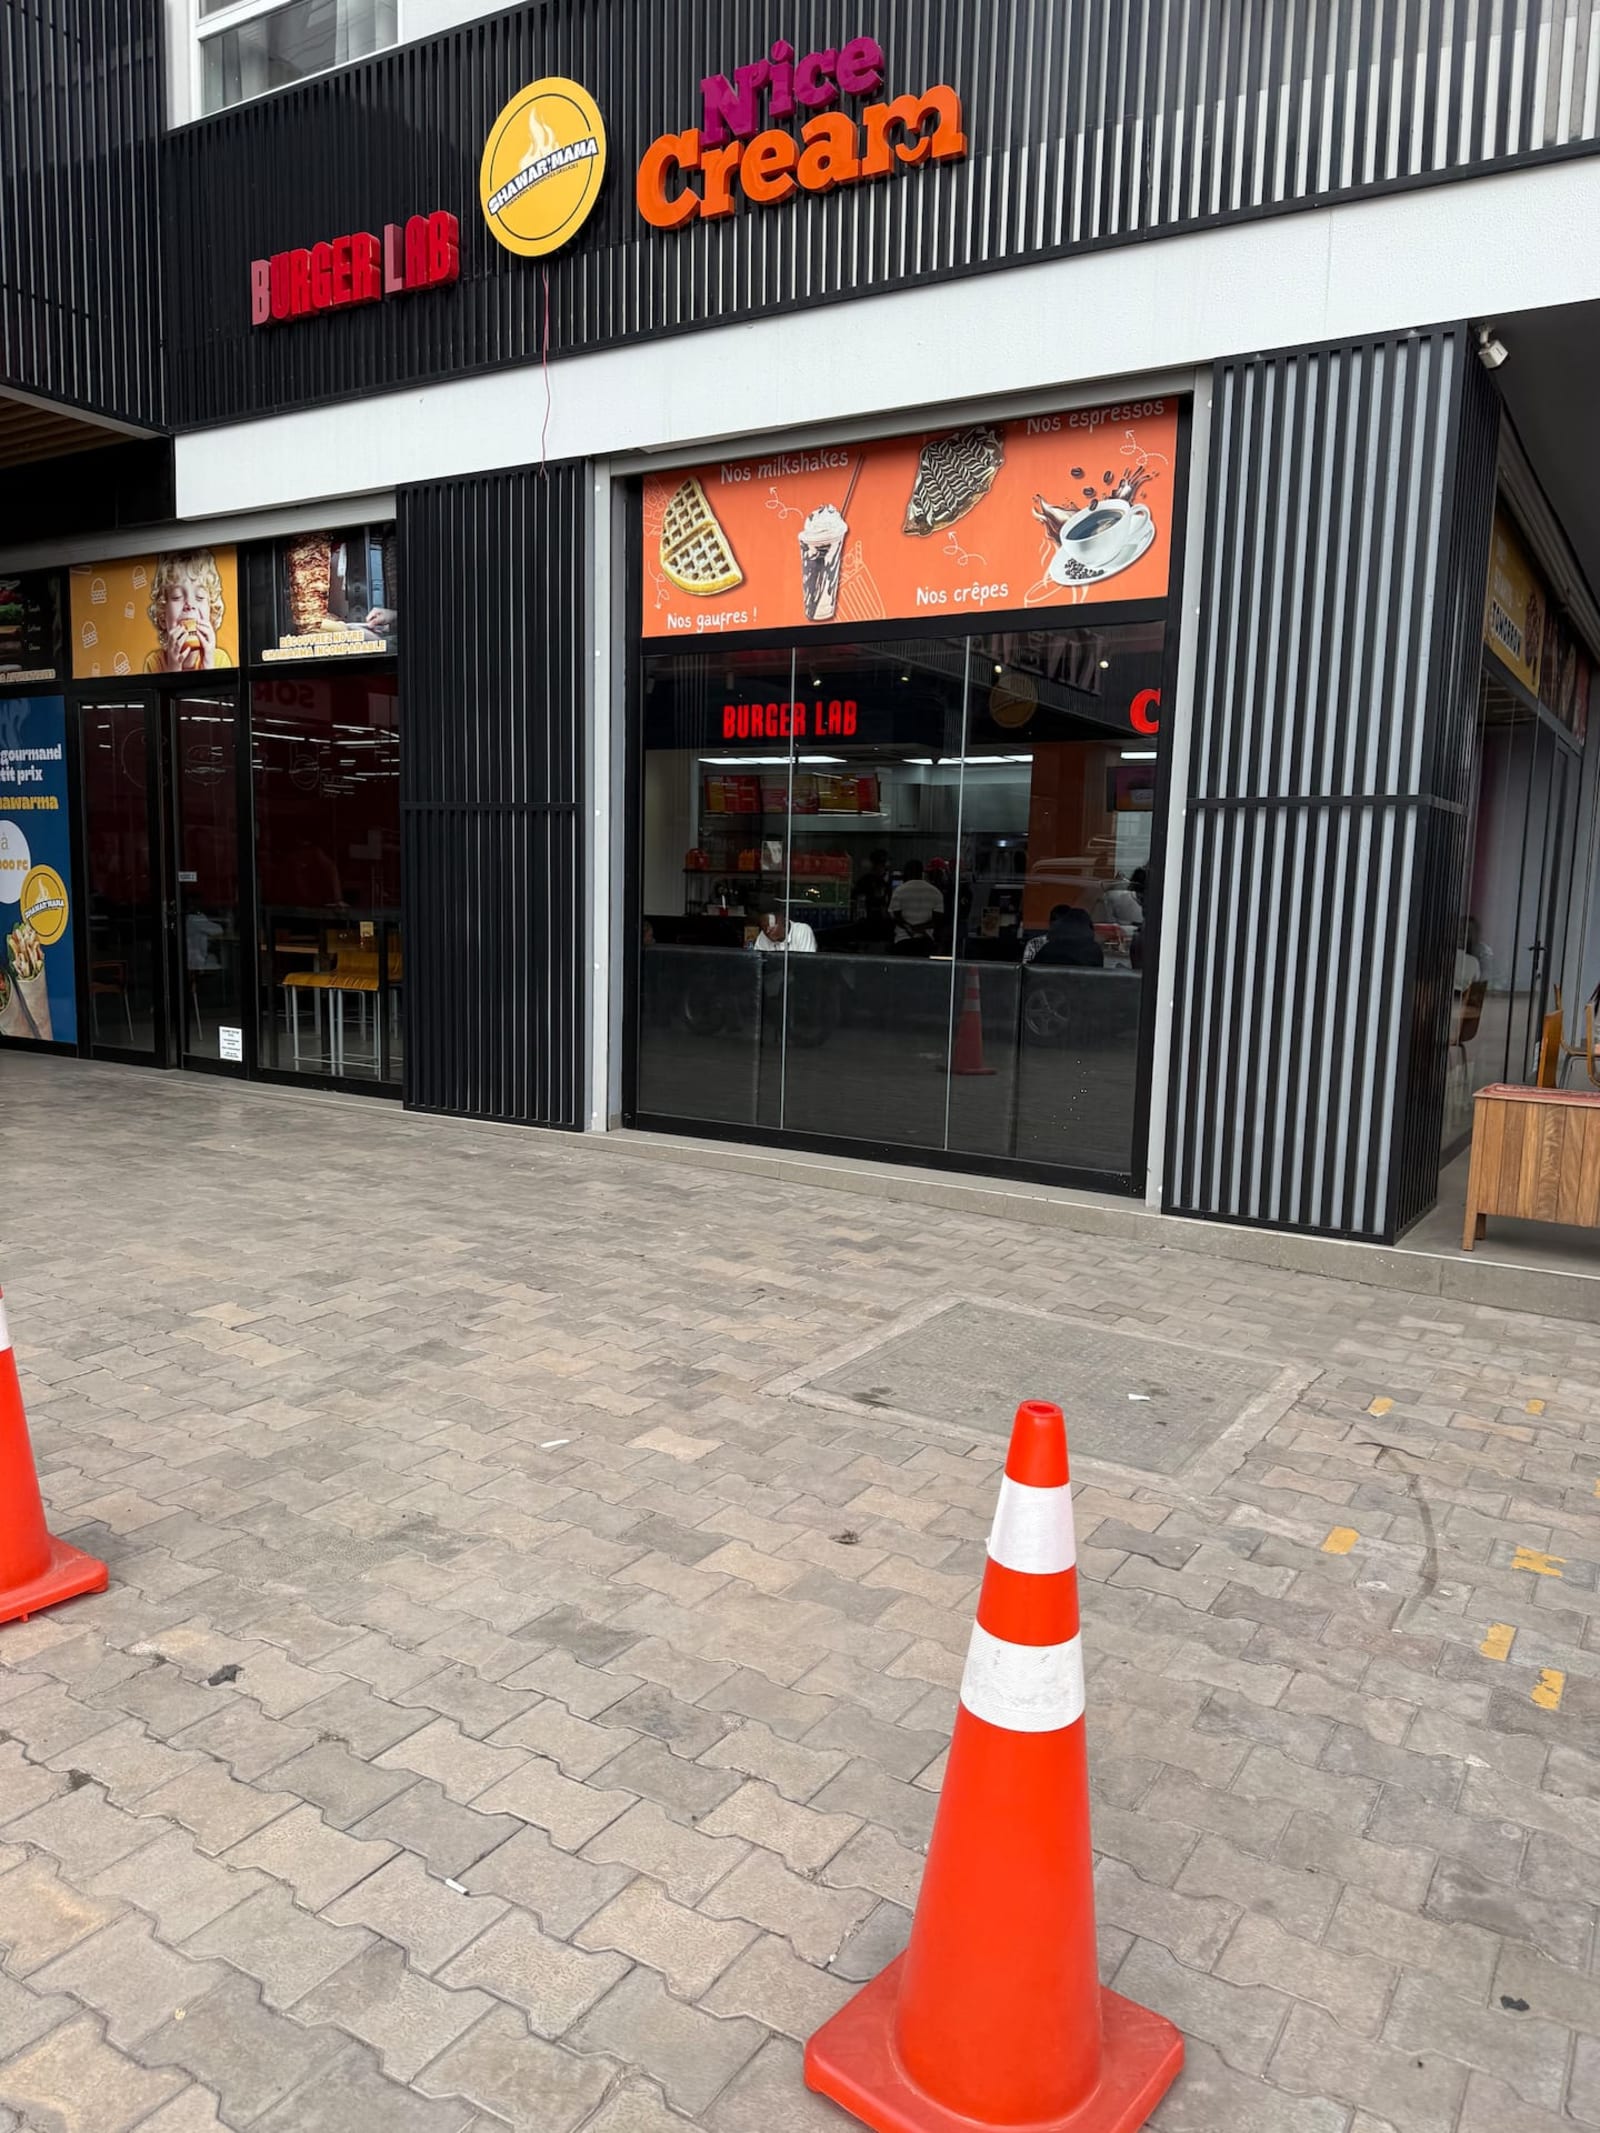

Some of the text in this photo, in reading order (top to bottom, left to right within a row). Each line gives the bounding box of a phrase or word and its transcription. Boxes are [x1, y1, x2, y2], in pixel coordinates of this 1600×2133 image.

[700, 36, 885, 149] Nice
[636, 84, 968, 229] Cream
[251, 209, 460, 326] BURGER LAB
[1027, 400, 1165, 435] Nos espressos
[720, 449, 849, 485] Nos milkshakes
[916, 581, 1009, 607] Nos crêpes
[667, 612, 692, 630] Nos
[696, 610, 748, 634] gaufres
[333, 629, 365, 645] NOTRE
[723, 700, 857, 739] BURGER LAB
[0, 743, 62, 766] gourmand
[17, 764, 43, 786] prix
[0, 795, 59, 811] awarma
[0, 859, 15, 871] 00
